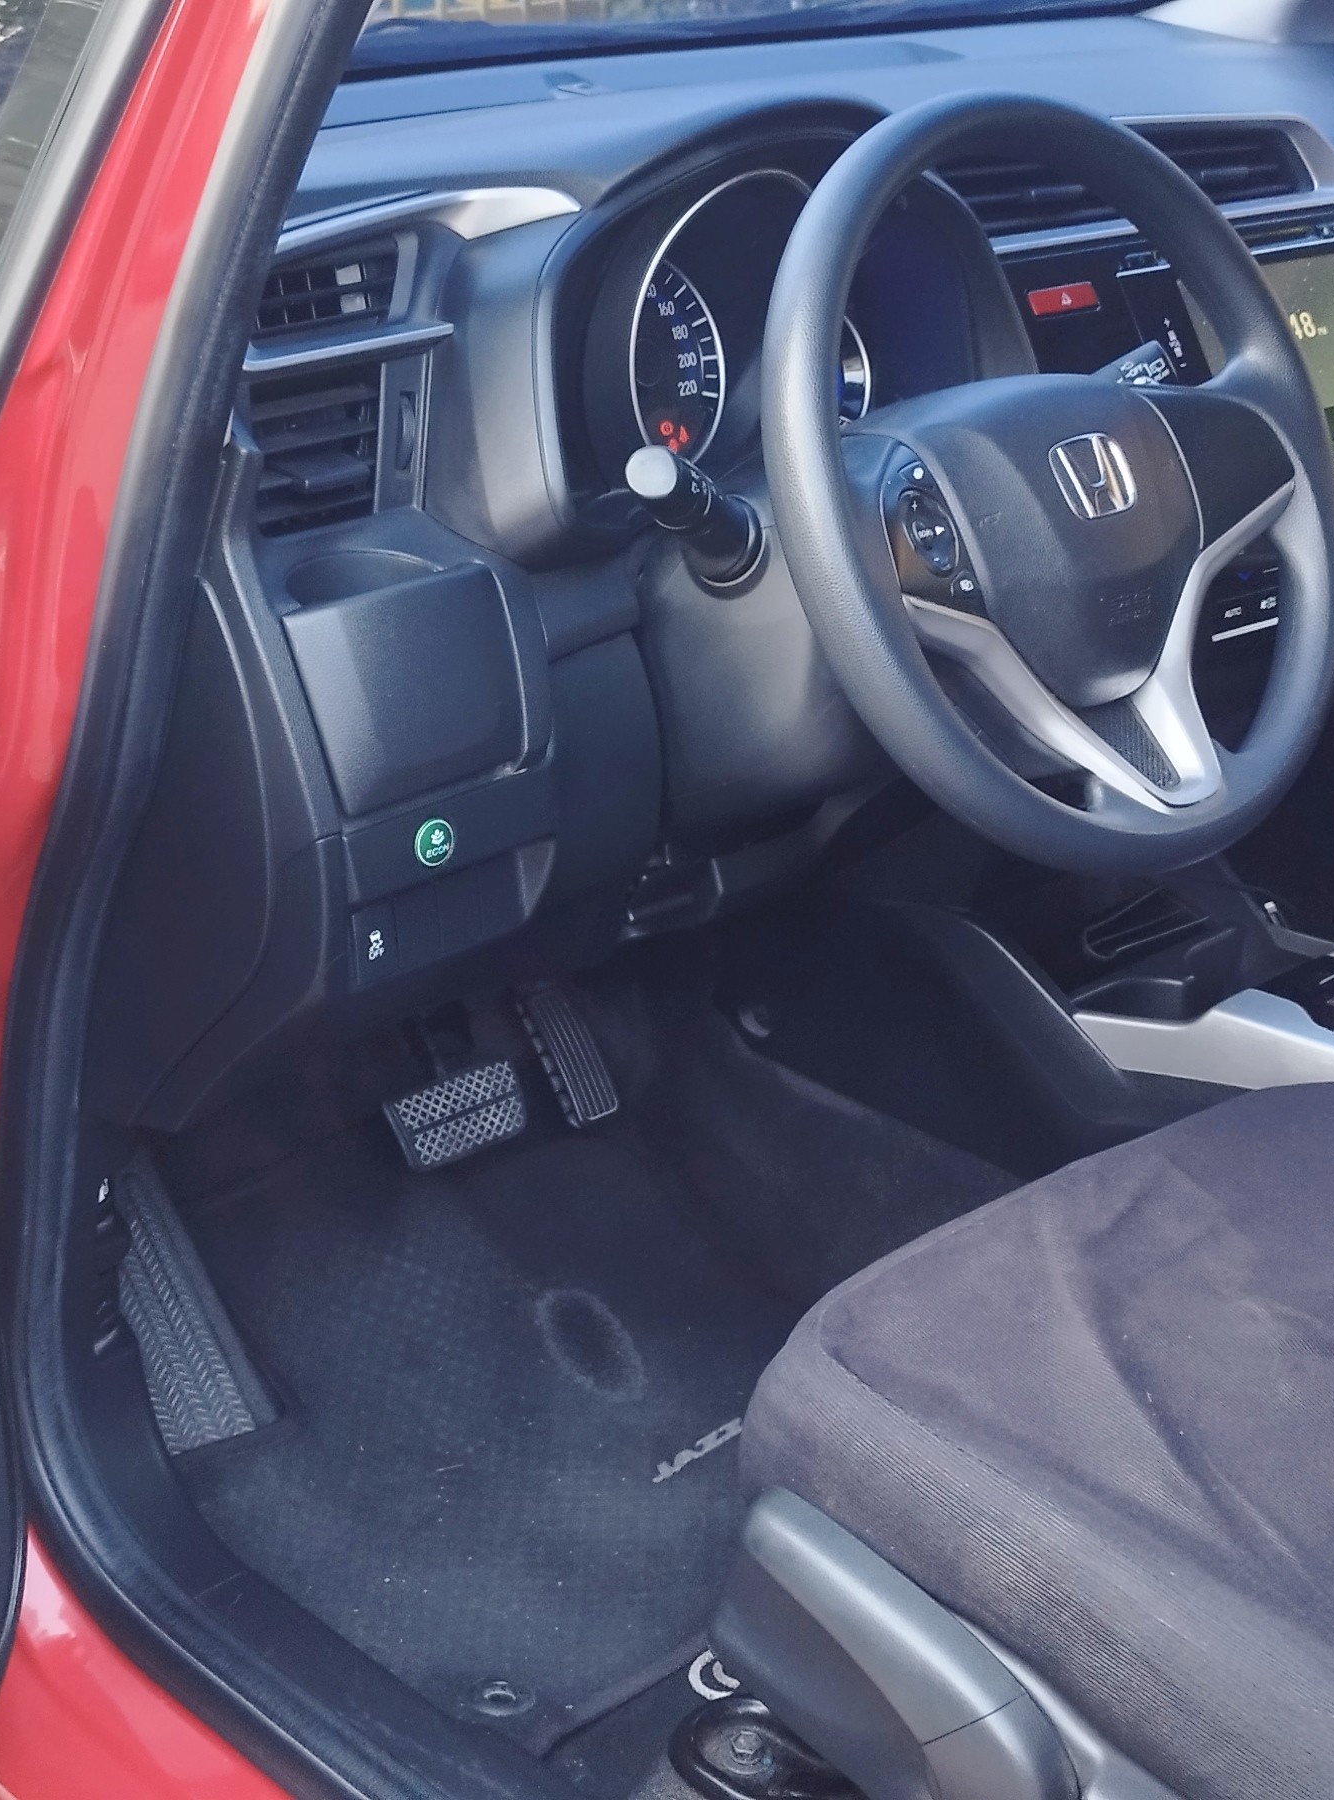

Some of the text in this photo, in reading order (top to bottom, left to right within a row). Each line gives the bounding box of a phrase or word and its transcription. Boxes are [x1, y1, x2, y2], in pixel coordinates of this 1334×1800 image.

[658, 301, 675, 316] 160
[672, 324, 689, 340] 180
[678, 352, 698, 369] 200
[678, 380, 698, 397] 220
[426, 842, 450, 859] ECON
[368, 946, 385, 960] OFF
